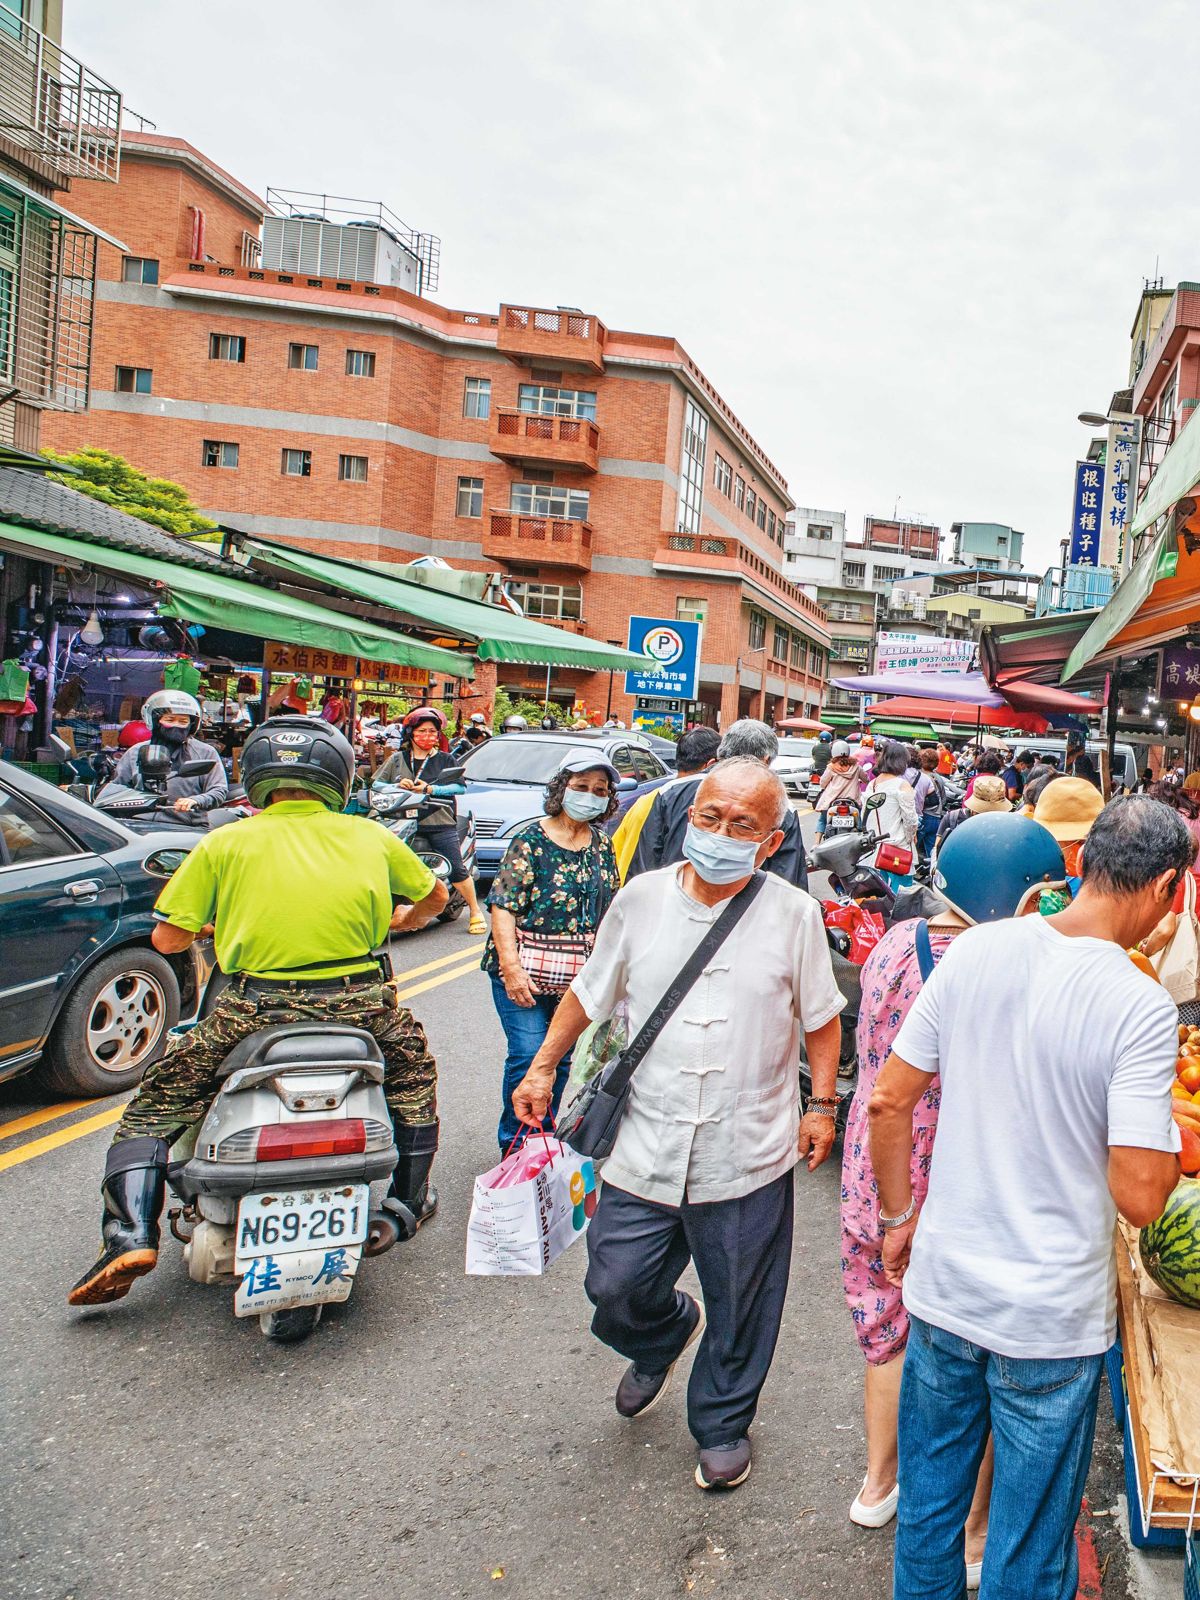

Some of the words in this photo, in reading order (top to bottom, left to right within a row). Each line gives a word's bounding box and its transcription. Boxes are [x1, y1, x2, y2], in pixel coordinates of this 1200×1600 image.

[637, 680, 682, 692] 地下停車場
[540, 1207, 550, 1237] SAN
[543, 1240, 551, 1266] XIA
[240, 1255, 282, 1297] 佳
[285, 1274, 314, 1284] KYMCO
[311, 1248, 353, 1286] 展
